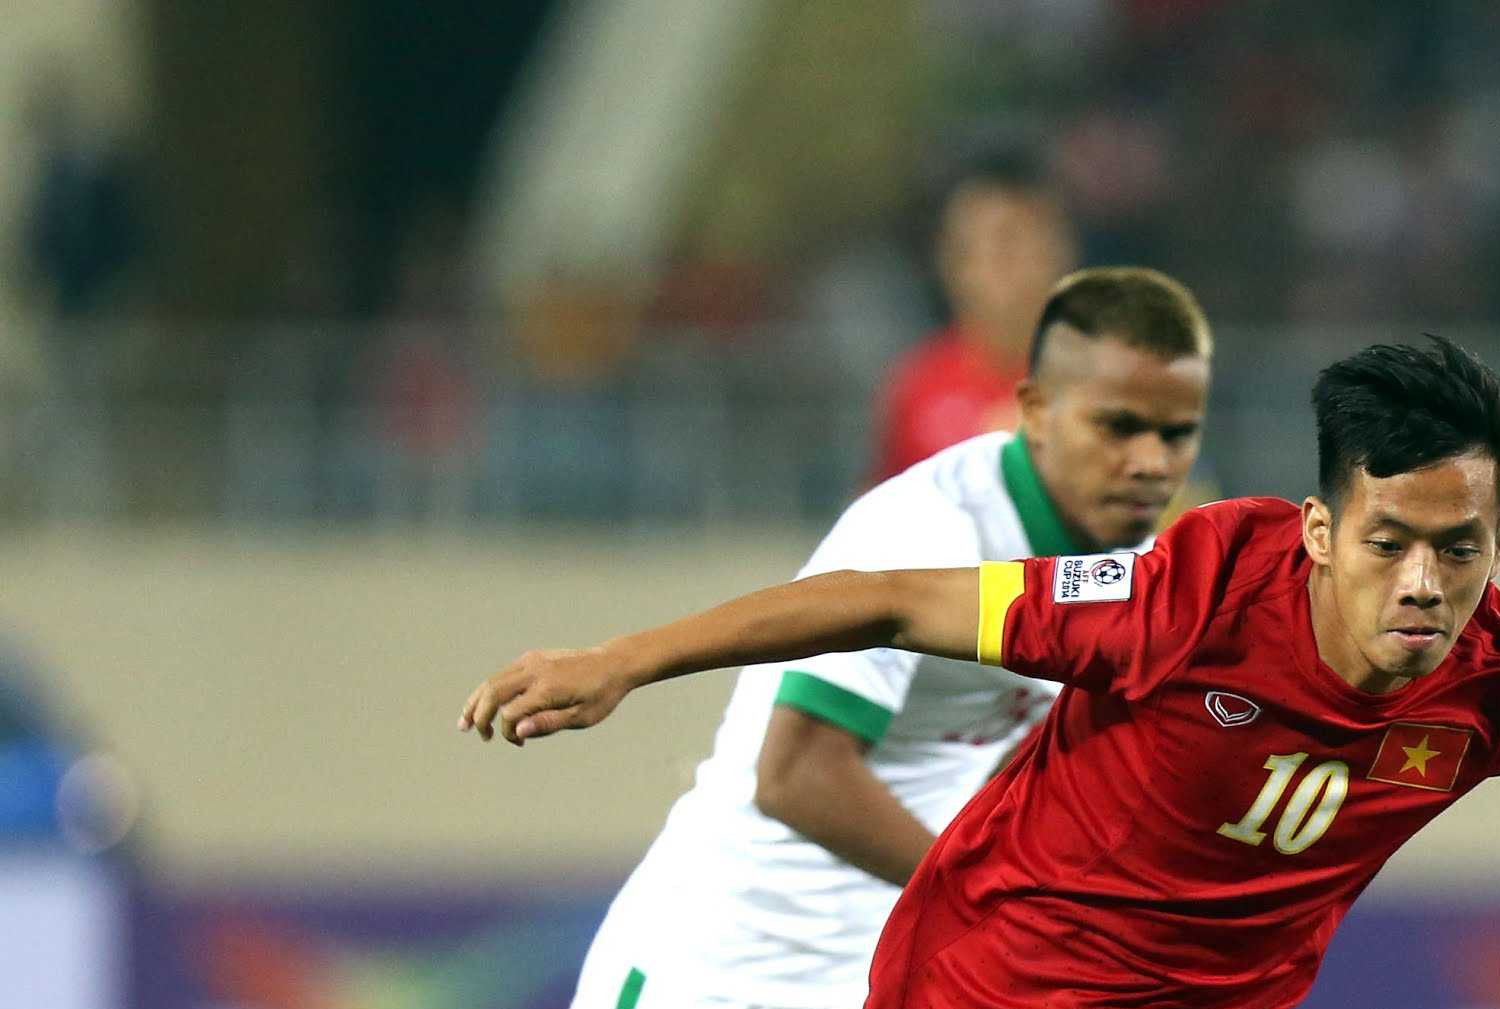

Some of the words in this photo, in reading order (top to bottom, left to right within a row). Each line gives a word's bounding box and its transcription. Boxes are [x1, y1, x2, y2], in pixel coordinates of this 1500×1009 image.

[1063, 560, 1073, 579] CUP
[1070, 560, 1083, 598] SUZUKI
[1061, 581, 1071, 598] 2014
[1217, 751, 1350, 856] 10
